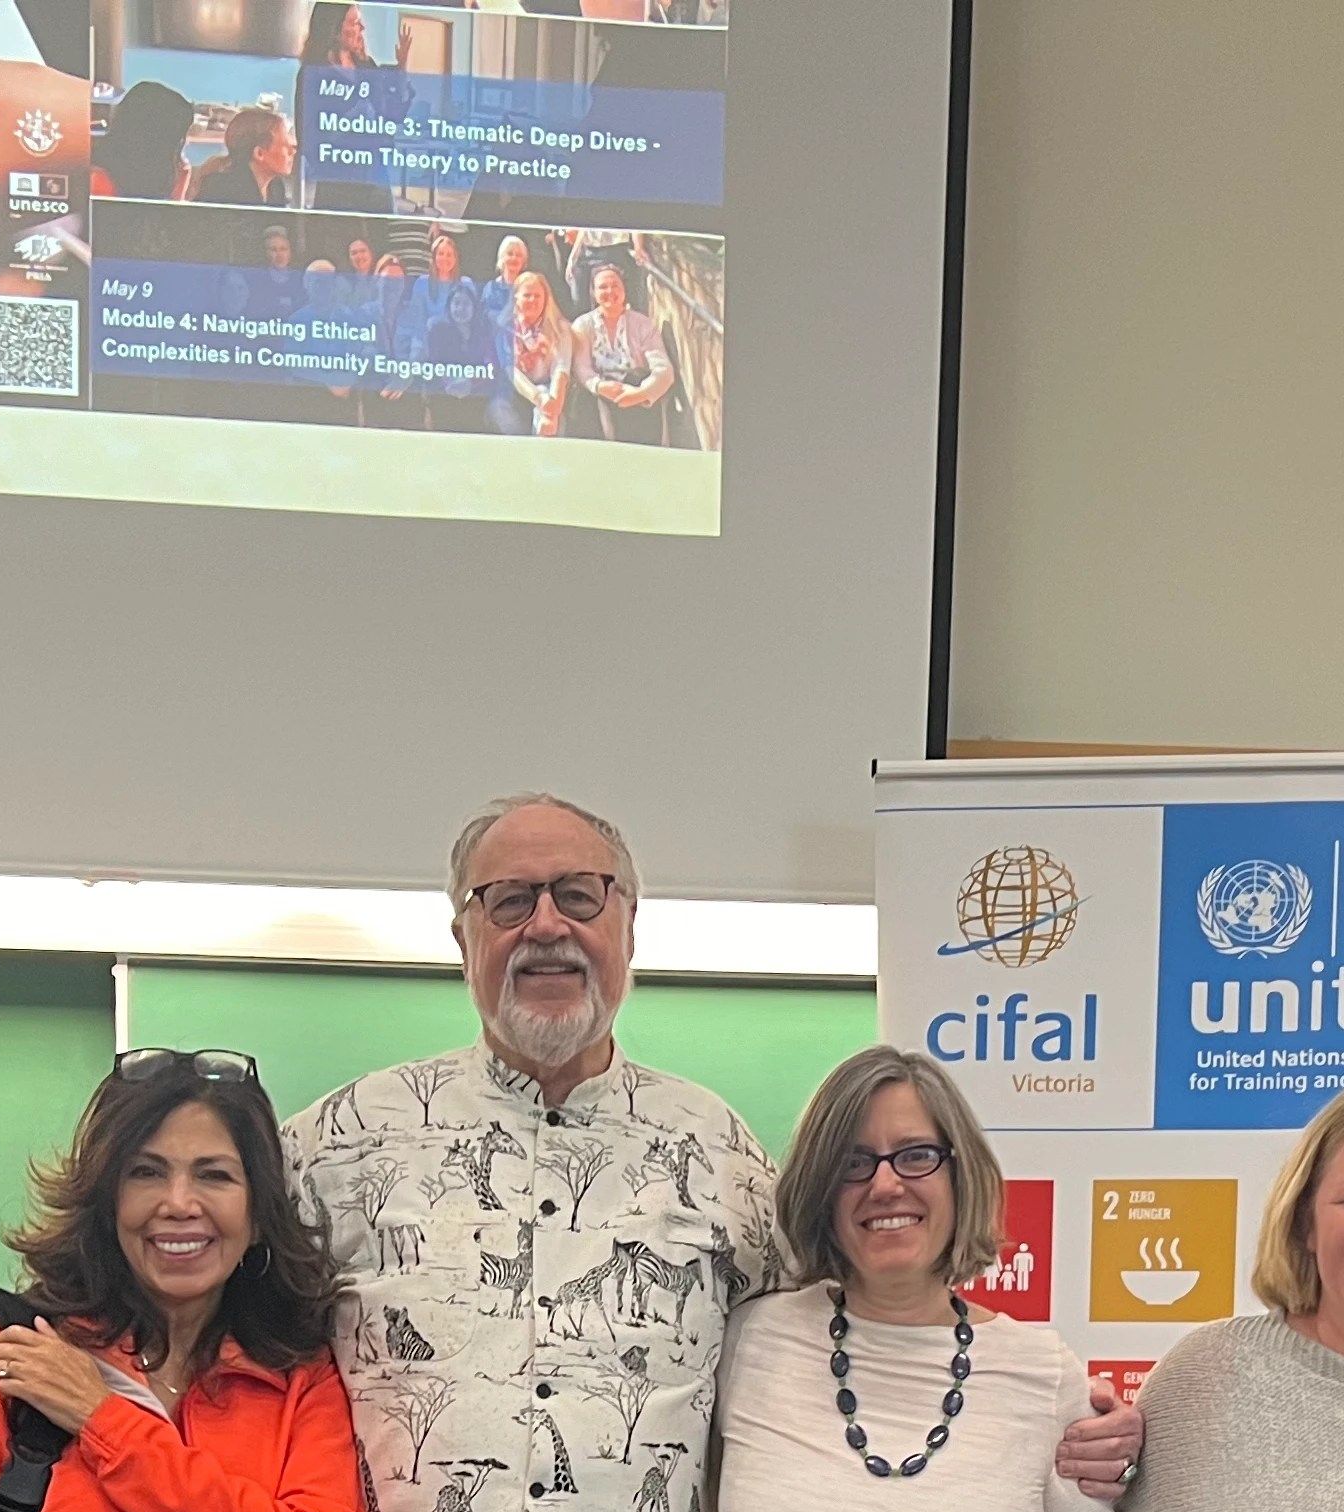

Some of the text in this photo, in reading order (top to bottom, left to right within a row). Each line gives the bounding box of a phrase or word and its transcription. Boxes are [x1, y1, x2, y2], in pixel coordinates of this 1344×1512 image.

[319, 79, 370, 99] May 8
[320, 112, 397, 136] Module
[403, 118, 421, 137] 3:
[428, 119, 524, 145] Thematic
[531, 126, 583, 152] Deep
[590, 131, 647, 152] Dives
[319, 144, 571, 179] From Theory to Practice
[9, 198, 69, 214] unesco
[101, 279, 153, 299] May 9
[102, 308, 376, 342] Module 4: Navigating Ethical
[101, 338, 494, 381] Complexities in Community Engagement
[925, 992, 1098, 1062] cifal
[1197, 1049, 1265, 1068] United
[1012, 1072, 1096, 1094] Victoria
[1189, 1072, 1219, 1091] for
[1224, 1073, 1307, 1093] Training
[1103, 1190, 1120, 1220] 2
[1129, 1190, 1155, 1203] ZERO
[1129, 1208, 1171, 1220] HUNGER
